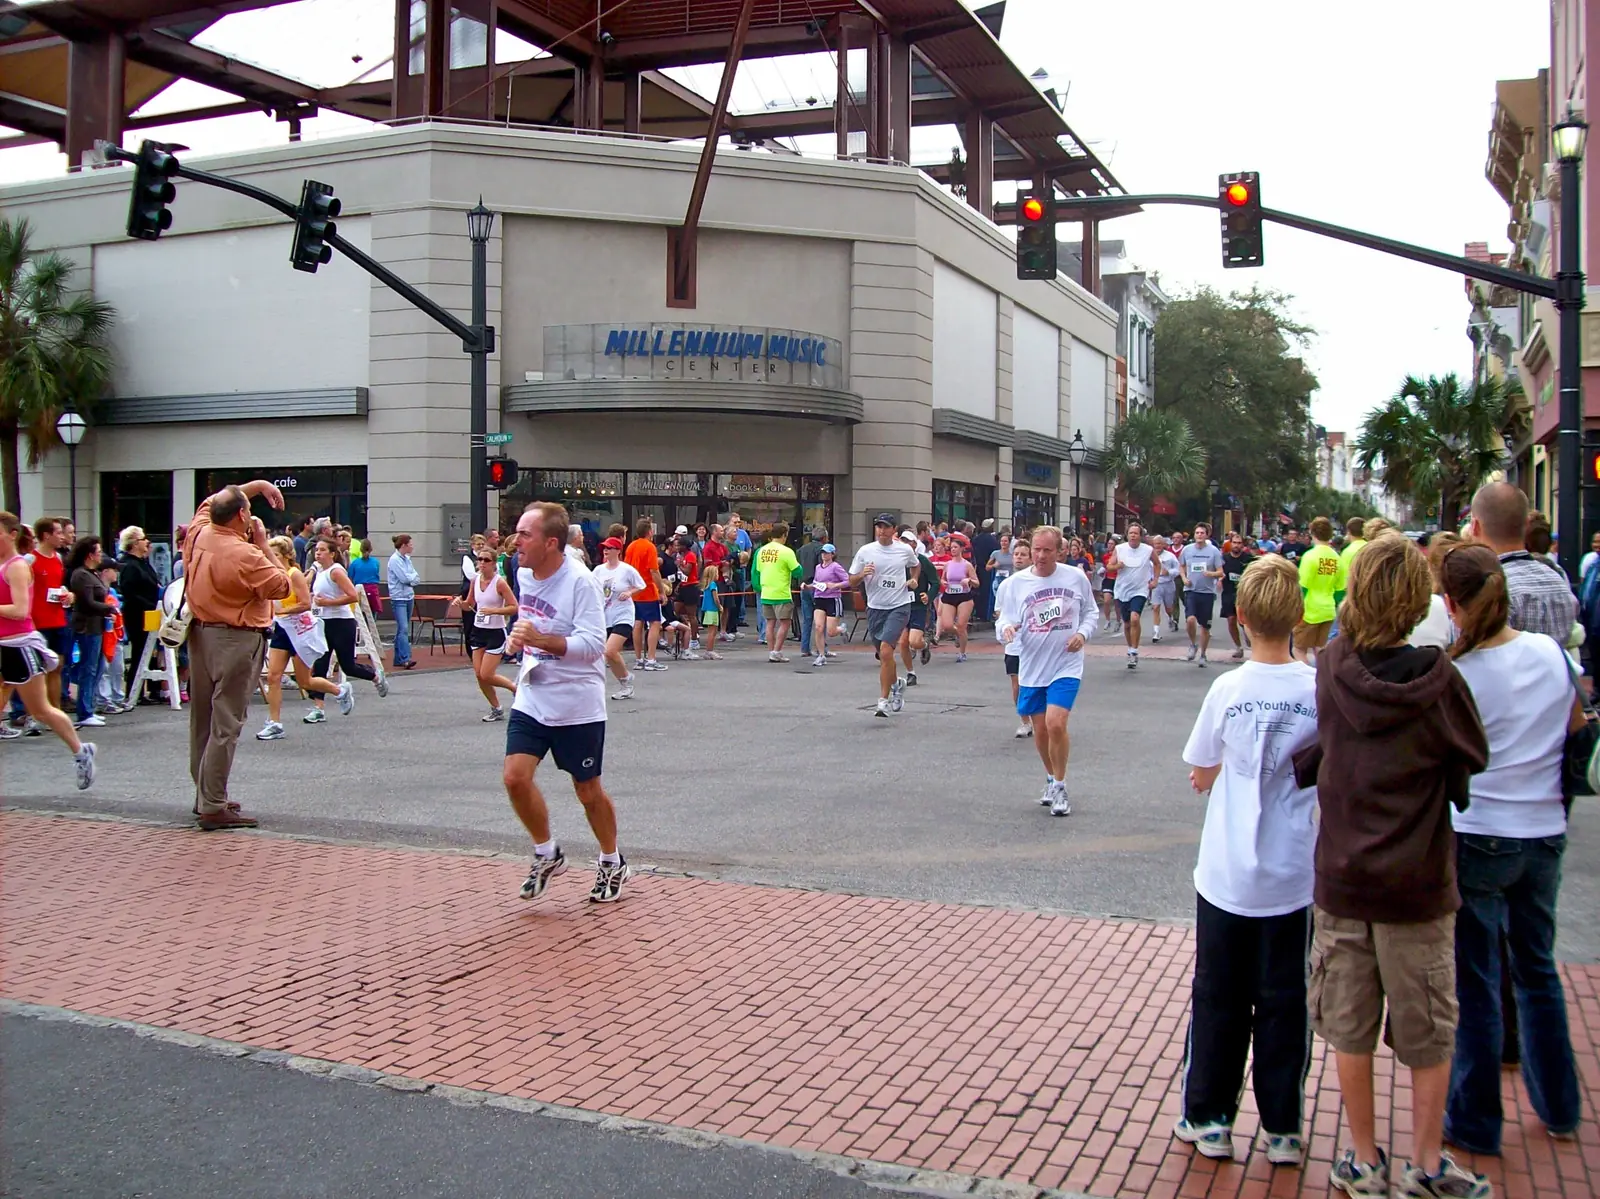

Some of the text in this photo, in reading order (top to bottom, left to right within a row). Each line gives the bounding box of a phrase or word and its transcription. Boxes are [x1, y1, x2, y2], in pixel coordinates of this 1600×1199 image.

[604, 330, 826, 366] MILLENNIUM MUSIC
[666, 360, 776, 373] CENTER
[486, 434, 507, 443] CALHOUN
[274, 476, 297, 488] cafe
[543, 479, 616, 489] music movies
[642, 481, 700, 491] MILLENNIUM
[729, 483, 757, 492] books
[1319, 557, 1337, 566] RACE
[882, 580, 896, 588] 293
[1039, 605, 1060, 623] 3200
[1256, 700, 1290, 712] Youth
